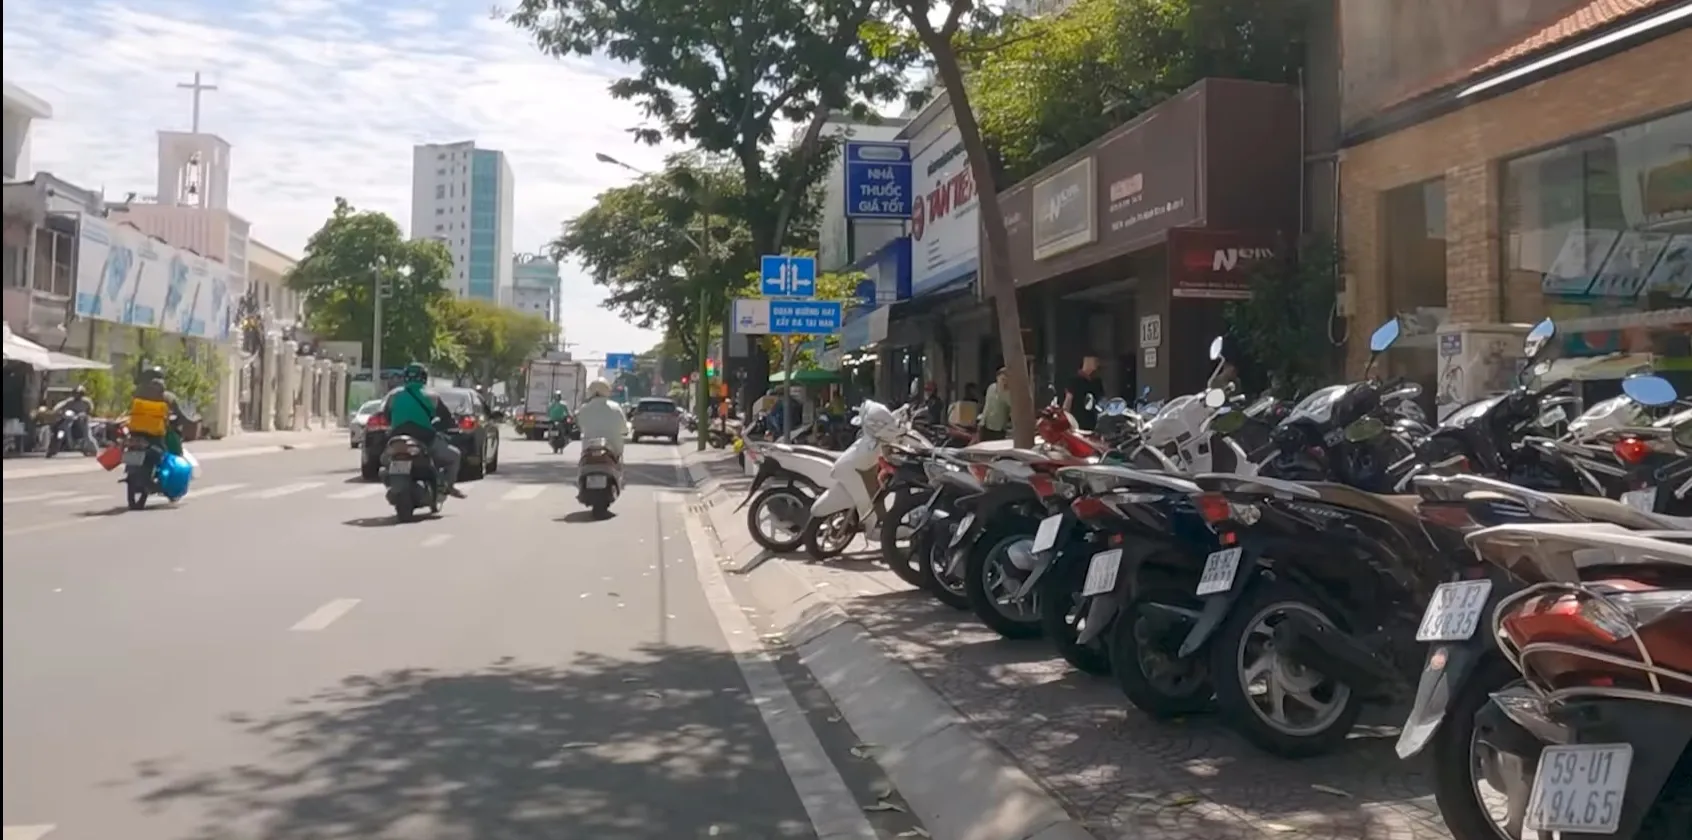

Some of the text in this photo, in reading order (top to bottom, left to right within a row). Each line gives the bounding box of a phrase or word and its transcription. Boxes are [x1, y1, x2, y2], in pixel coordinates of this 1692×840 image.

[858, 196, 905, 212] GIÁ TỐT
[1550, 750, 1615, 786] 59-U1
[1534, 789, 1617, 825] 494.65
